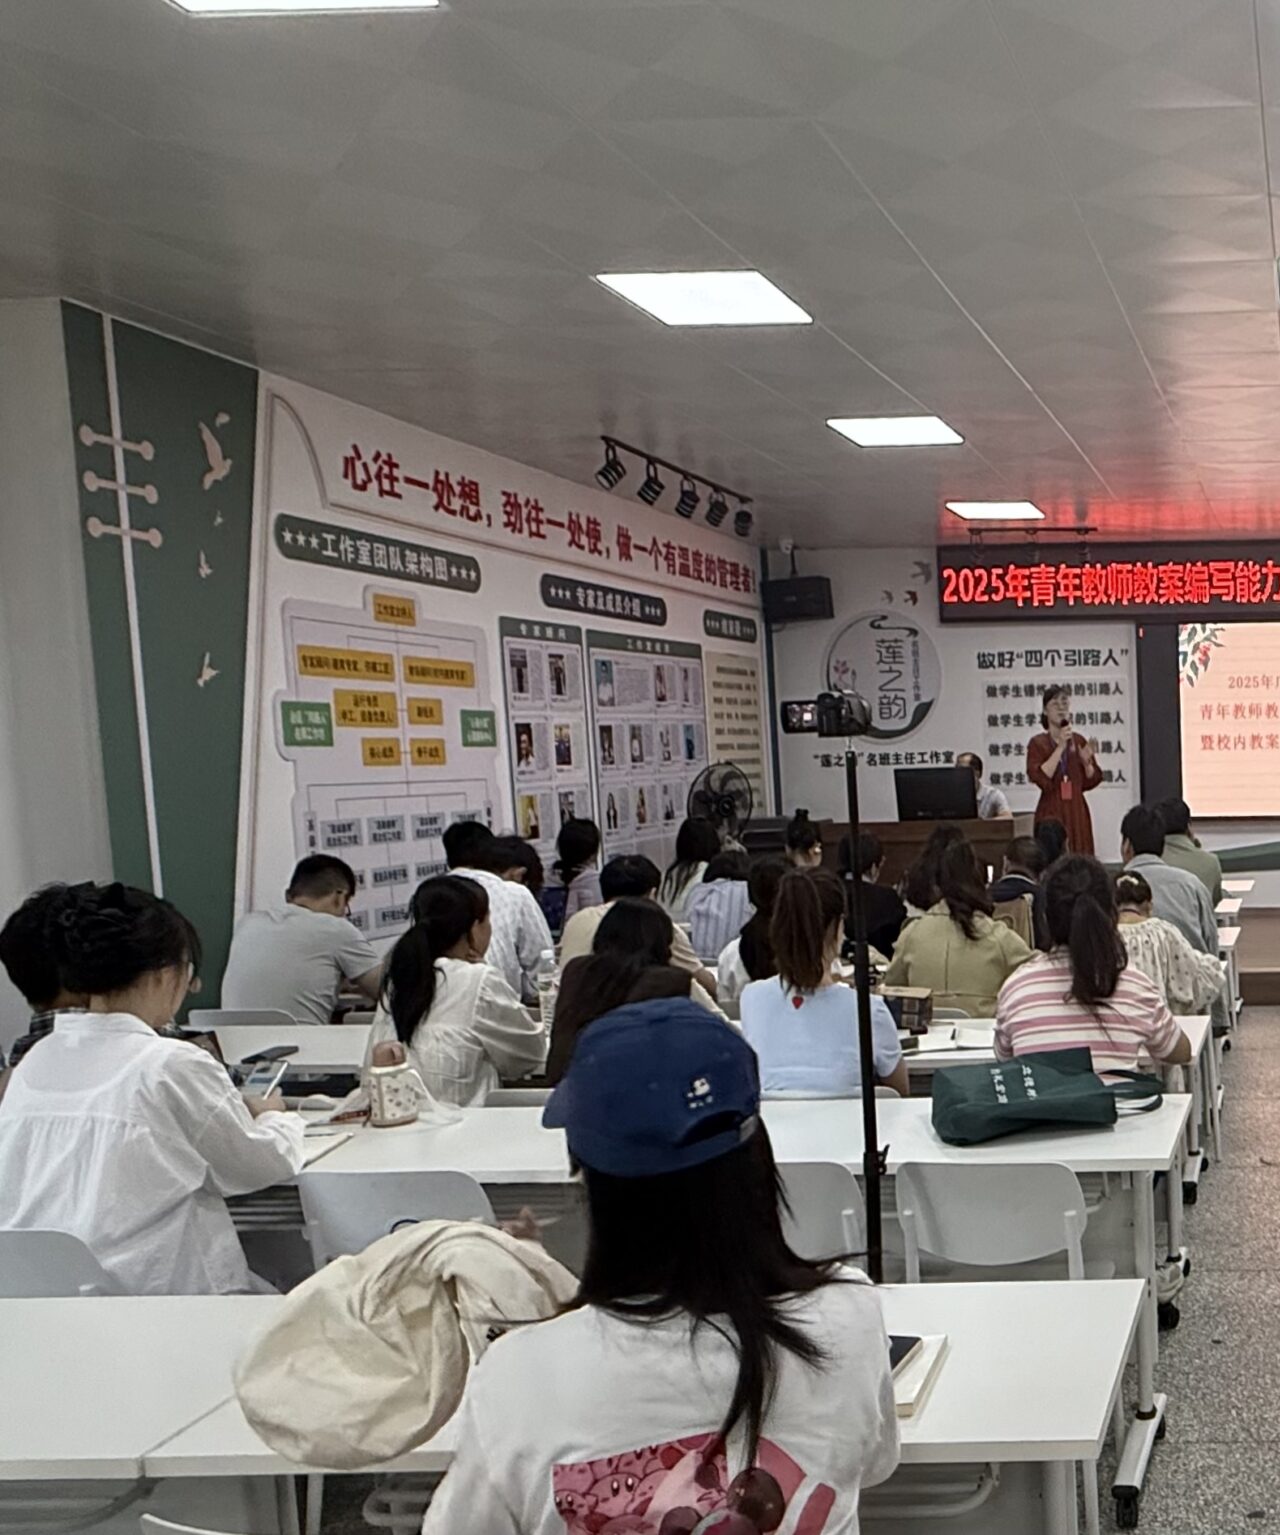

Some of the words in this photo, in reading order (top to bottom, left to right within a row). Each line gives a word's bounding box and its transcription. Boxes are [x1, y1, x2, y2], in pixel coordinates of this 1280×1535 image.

[321, 532, 449, 582] 工作室团队架构图
[977, 648, 1129, 670] 做好“四个引路人”
[813, 750, 955, 768] “莲之”名班主任工作室
